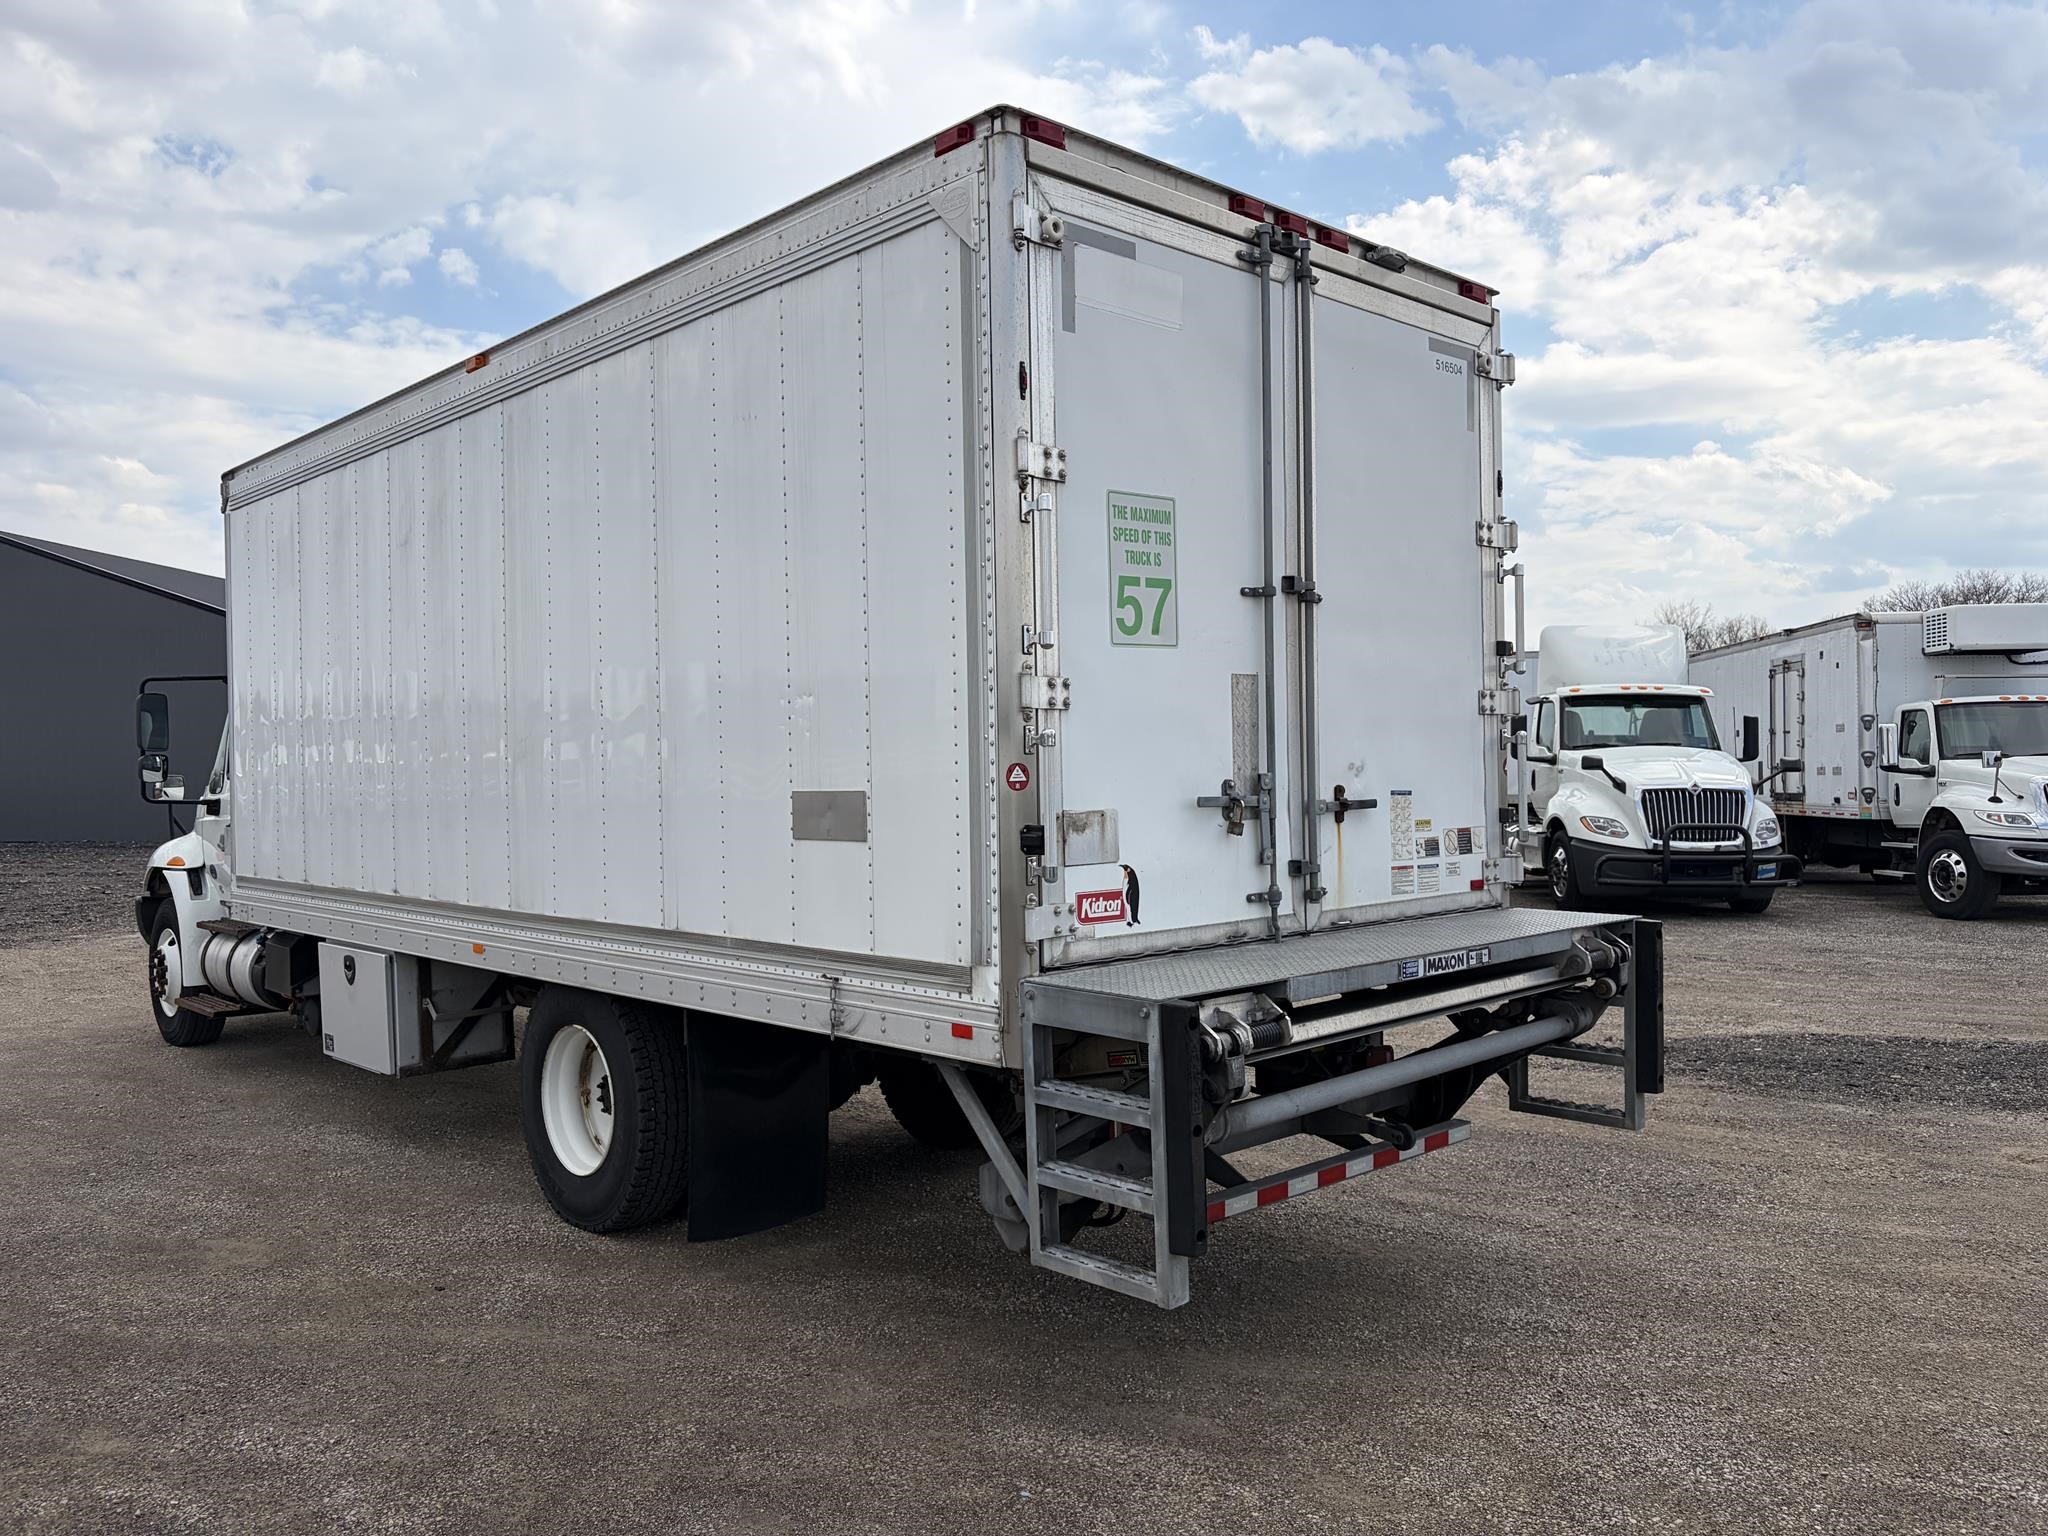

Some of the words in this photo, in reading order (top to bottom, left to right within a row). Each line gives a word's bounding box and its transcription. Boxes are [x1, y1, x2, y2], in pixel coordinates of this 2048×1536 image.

[1435, 359, 1463, 375] 516504
[1112, 504, 1128, 520] THE
[1130, 507, 1171, 525] MAXIMUM
[1112, 526, 1140, 543] SPEED
[1141, 530, 1152, 545] OF
[1154, 531, 1172, 547] THIS
[1125, 550, 1152, 566] TRUCK
[1154, 552, 1162, 567] IS
[1115, 575, 1172, 636] 57
[1081, 898, 1122, 919] Kidron
[1427, 953, 1465, 974] MAXON
